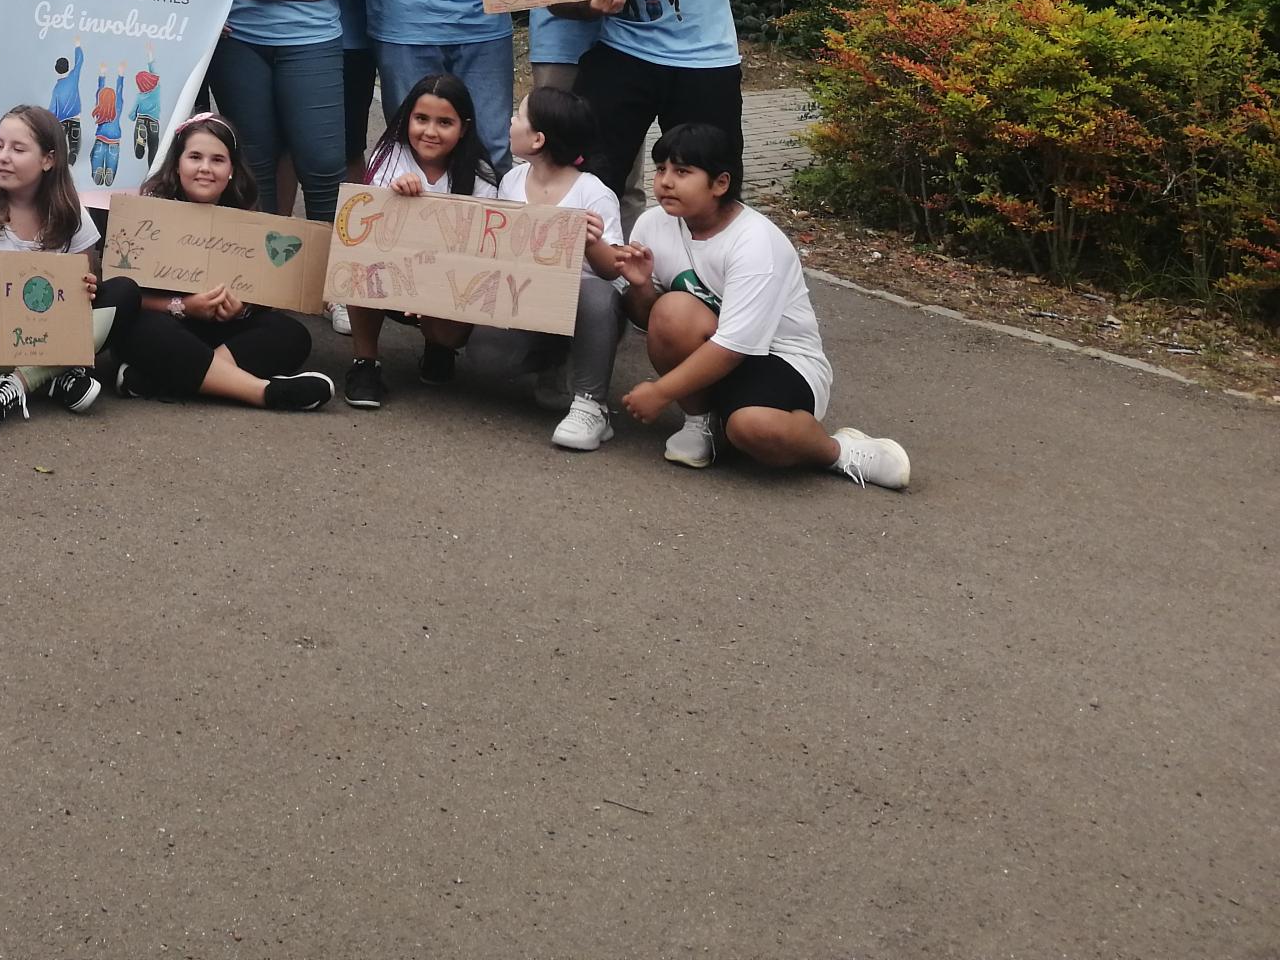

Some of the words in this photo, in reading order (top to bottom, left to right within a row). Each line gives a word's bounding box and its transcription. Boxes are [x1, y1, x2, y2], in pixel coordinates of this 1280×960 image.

[34, 1, 75, 40] Get
[78, 8, 190, 41] involved!
[335, 191, 410, 253] GO
